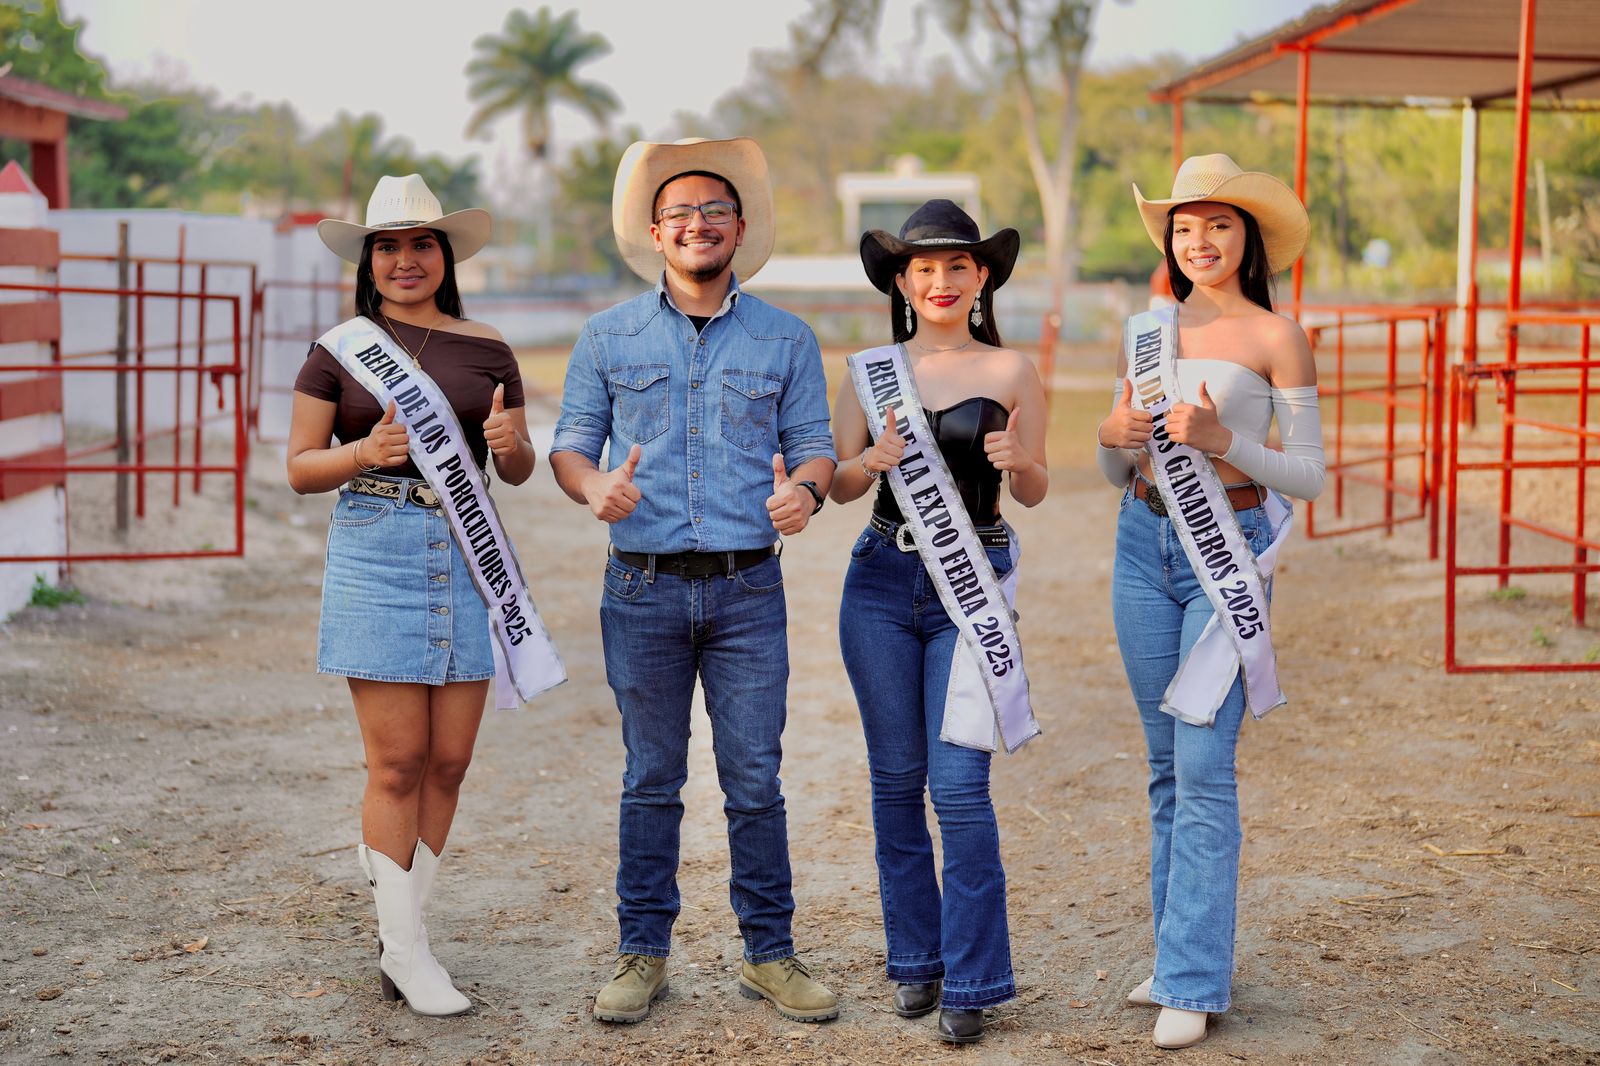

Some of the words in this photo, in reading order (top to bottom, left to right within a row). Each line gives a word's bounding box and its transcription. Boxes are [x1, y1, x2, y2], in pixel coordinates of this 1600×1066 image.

[1135, 326, 1162, 378] REINA
[866, 358, 904, 419] REINA
[1137, 375, 1167, 410] DE
[355, 343, 409, 391] REINA
[394, 385, 430, 418] DE
[412, 411, 451, 454] LOS
[436, 453, 512, 598] PORCICULTORES
[500, 594, 533, 646] 2025
[898, 450, 930, 486] LA
[911, 483, 960, 548] EXPO
[1164, 455, 1239, 582] GANADEROS
[939, 547, 989, 618] FERIA
[1219, 579, 1265, 640] 2025
[973, 616, 1014, 678] 2025
